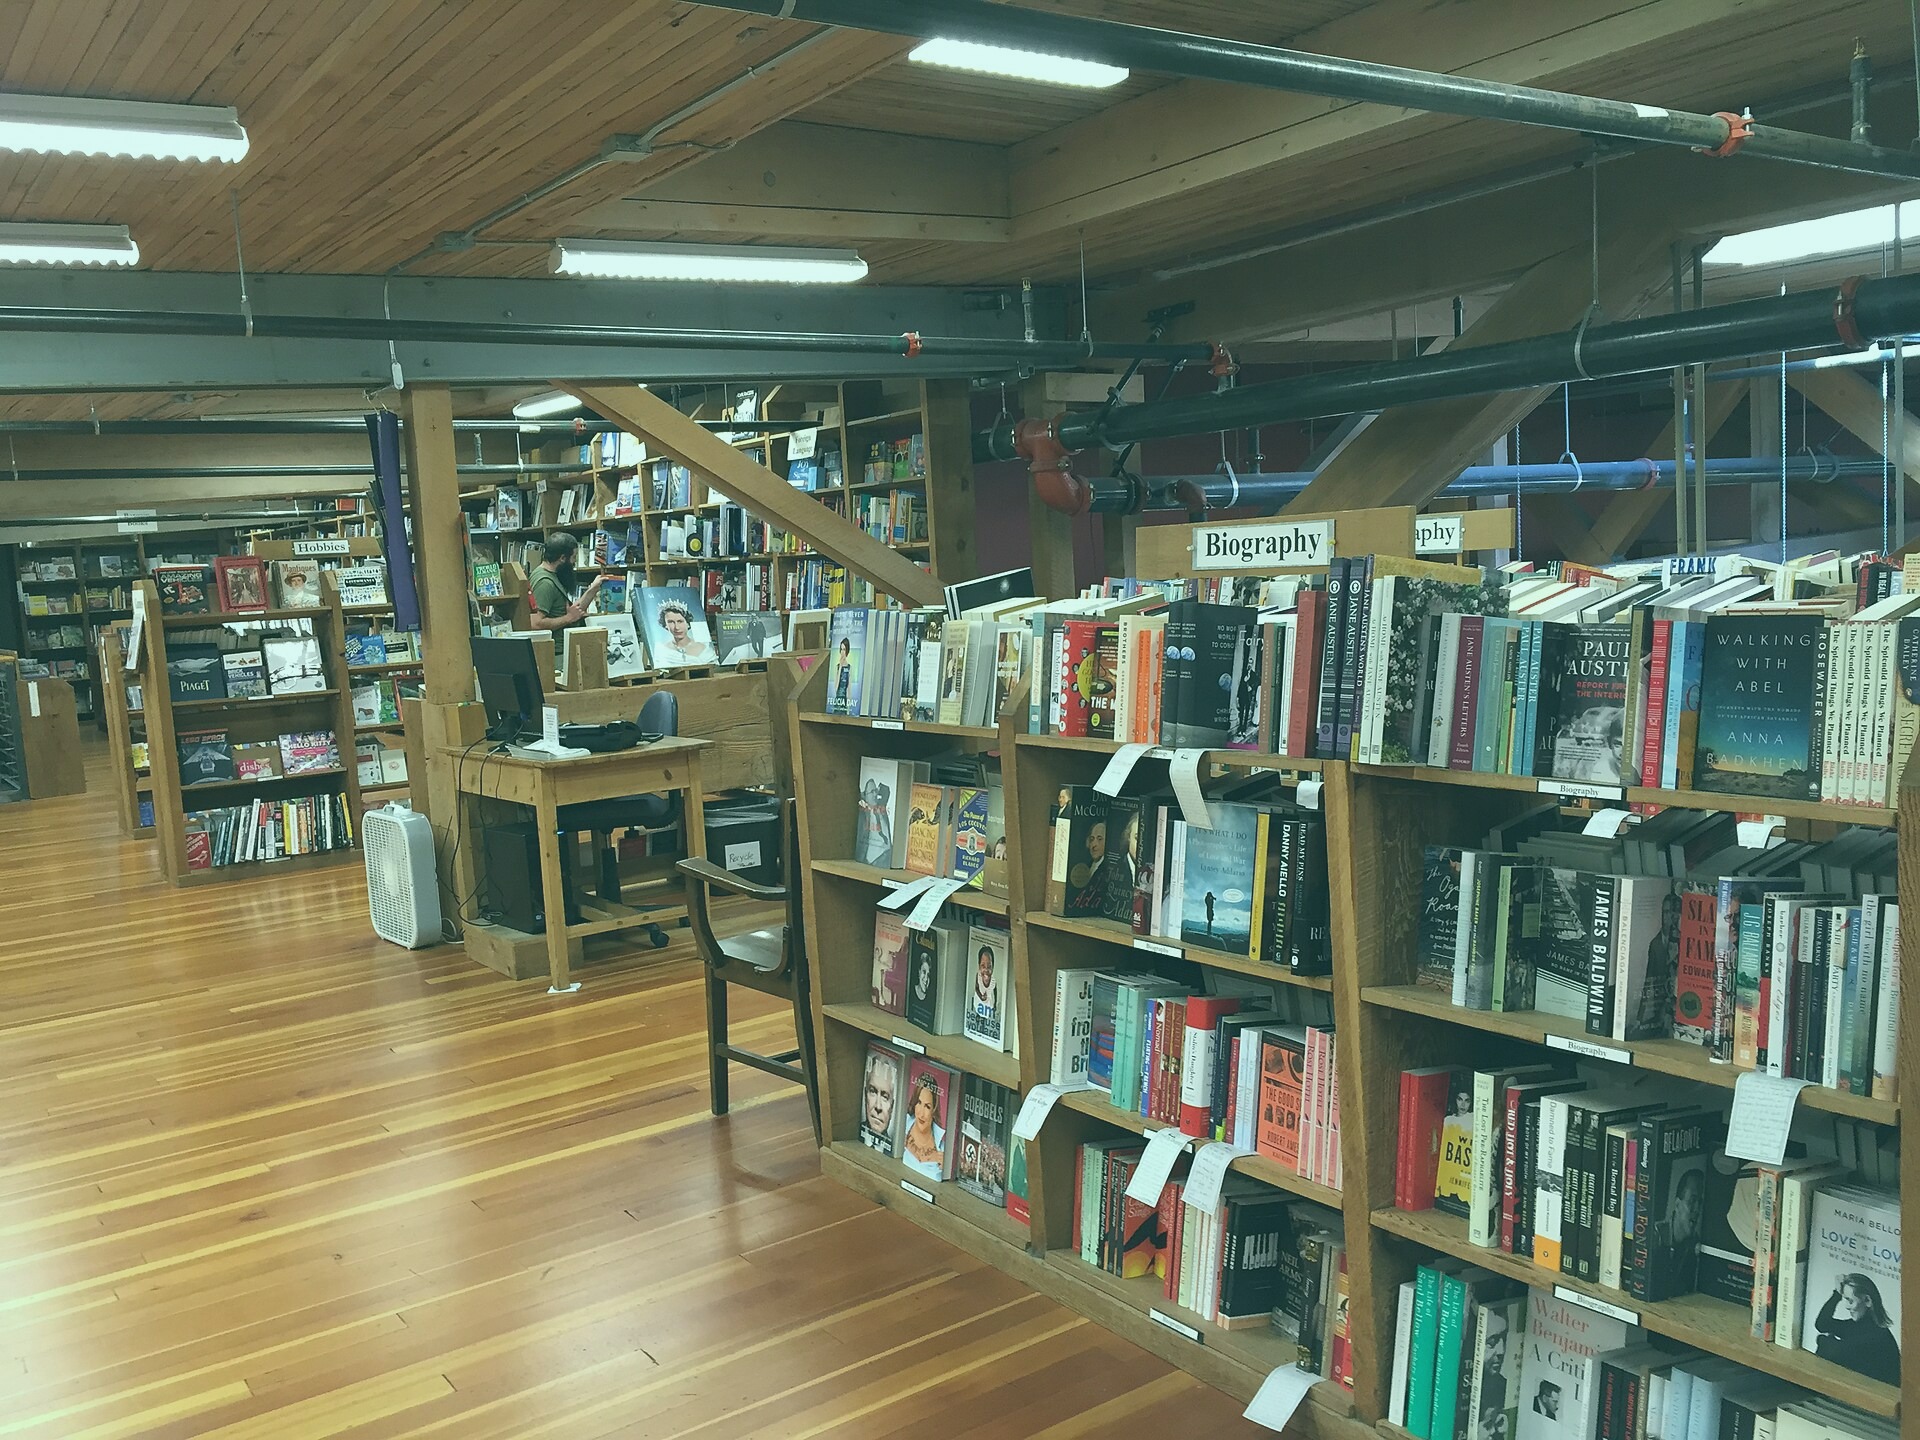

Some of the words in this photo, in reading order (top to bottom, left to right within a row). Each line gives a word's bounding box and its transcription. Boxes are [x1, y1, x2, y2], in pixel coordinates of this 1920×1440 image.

[298, 543, 346, 552] Hobbies
[1205, 528, 1321, 562] Biography
[282, 564, 316, 573] Mantiques
[1670, 558, 1716, 574] FRANK
[1328, 598, 1338, 622] JANE
[1348, 598, 1358, 622] JANE
[1326, 624, 1336, 665] AUSTEN
[1346, 625, 1356, 666] AUSTEN
[1466, 636, 1475, 657] JANE
[1521, 627, 1530, 653] PAUL
[1532, 628, 1542, 654] PAUL
[1717, 634, 1811, 646] WALKING
[1736, 658, 1786, 669] WITH
[1831, 645, 1840, 680] Splendid
[1848, 645, 1856, 679] Splendid
[1864, 646, 1872, 680] Splendid
[1881, 646, 1890, 680] Splendid
[1910, 629, 1920, 682] CATHERINE
[1357, 655, 1365, 687] WORLD
[1463, 659, 1472, 699] AUSTEN'S
[1517, 660, 1528, 701] AUSTER
[1528, 662, 1541, 703] AUSTER
[1814, 633, 1827, 717] ROSEWATER
[180, 680, 210, 692] PIAGET
[1735, 681, 1784, 694] ABEL
[1828, 682, 1838, 708] Things
[1846, 682, 1854, 708] Things
[1862, 683, 1870, 708] Things
[1878, 683, 1888, 709] Things
[828, 698, 845, 706] FELICIA
[1091, 696, 1107, 709] THE
[1460, 701, 1469, 738] LETTERS
[289, 740, 310, 748] HELLO
[311, 740, 331, 748] KITTY
[1727, 732, 1784, 744] ANNA
[1826, 724, 1834, 754] Planned
[1844, 724, 1852, 754] Planned
[1860, 724, 1868, 756] Planned
[1876, 725, 1884, 758] Planned
[1706, 752, 1802, 770] BADKHEN
[1560, 785, 1599, 796] Biography
[911, 840, 923, 848] FISH
[1211, 830, 1228, 838] WHAT
[1281, 824, 1291, 860] DANNY
[729, 852, 754, 863] Recycle
[1233, 857, 1246, 866] War
[1298, 848, 1306, 860] MY
[1108, 867, 1124, 880] John
[1278, 861, 1290, 898] AIELLO
[1426, 866, 1440, 880] The
[1594, 888, 1610, 938] JAMES
[1764, 902, 1773, 938] JOSEPH
[1866, 900, 1875, 916] the
[1816, 916, 1824, 940] JULIAN
[1852, 917, 1860, 945] MAGGIE
[1864, 919, 1874, 940] girl
[1619, 916, 1628, 974] BALENCIAGA
[1741, 931, 1760, 971] BALLARD
[1862, 942, 1872, 966] with
[1546, 952, 1576, 966] JAMES
[1589, 945, 1607, 1016] BALDWIN
[1862, 970, 1868, 982] no
[977, 1003, 996, 1020] am
[1858, 987, 1866, 1016] name
[1887, 990, 1898, 1032] Beautiful
[966, 1010, 1000, 1029] because
[1154, 1022, 1163, 1052] Nomad
[911, 1076, 944, 1096] LANCASTER
[1265, 1086, 1277, 1102] THE
[1278, 1088, 1295, 1109] GOOD
[964, 1094, 1004, 1124] GOEBBELS
[1548, 1102, 1558, 1134] Damned
[1267, 1131, 1286, 1146] ROBERT
[1663, 1127, 1700, 1154] BELAFONTE
[1610, 1168, 1618, 1196] Borstal
[1608, 1198, 1617, 1214] Boy
[1634, 1173, 1650, 1269] BELAFONTE
[1834, 1209, 1865, 1225] MARIA
[1868, 1220, 1900, 1236] BELLO
[1822, 1228, 1856, 1250] LOVE
[1821, 1242, 1866, 1262] QUESTIONING
[1416, 1270, 1426, 1296] Saul
[1428, 1274, 1436, 1288] The
[1442, 1281, 1452, 1306] Saul
[1453, 1285, 1462, 1301] The
[1426, 1290, 1434, 1306] Life
[1452, 1302, 1460, 1318] Life
[1414, 1299, 1424, 1338] Bellow
[1536, 1297, 1590, 1332] Walter
[1439, 1310, 1450, 1348] Bellow
[1534, 1344, 1542, 1362] A
